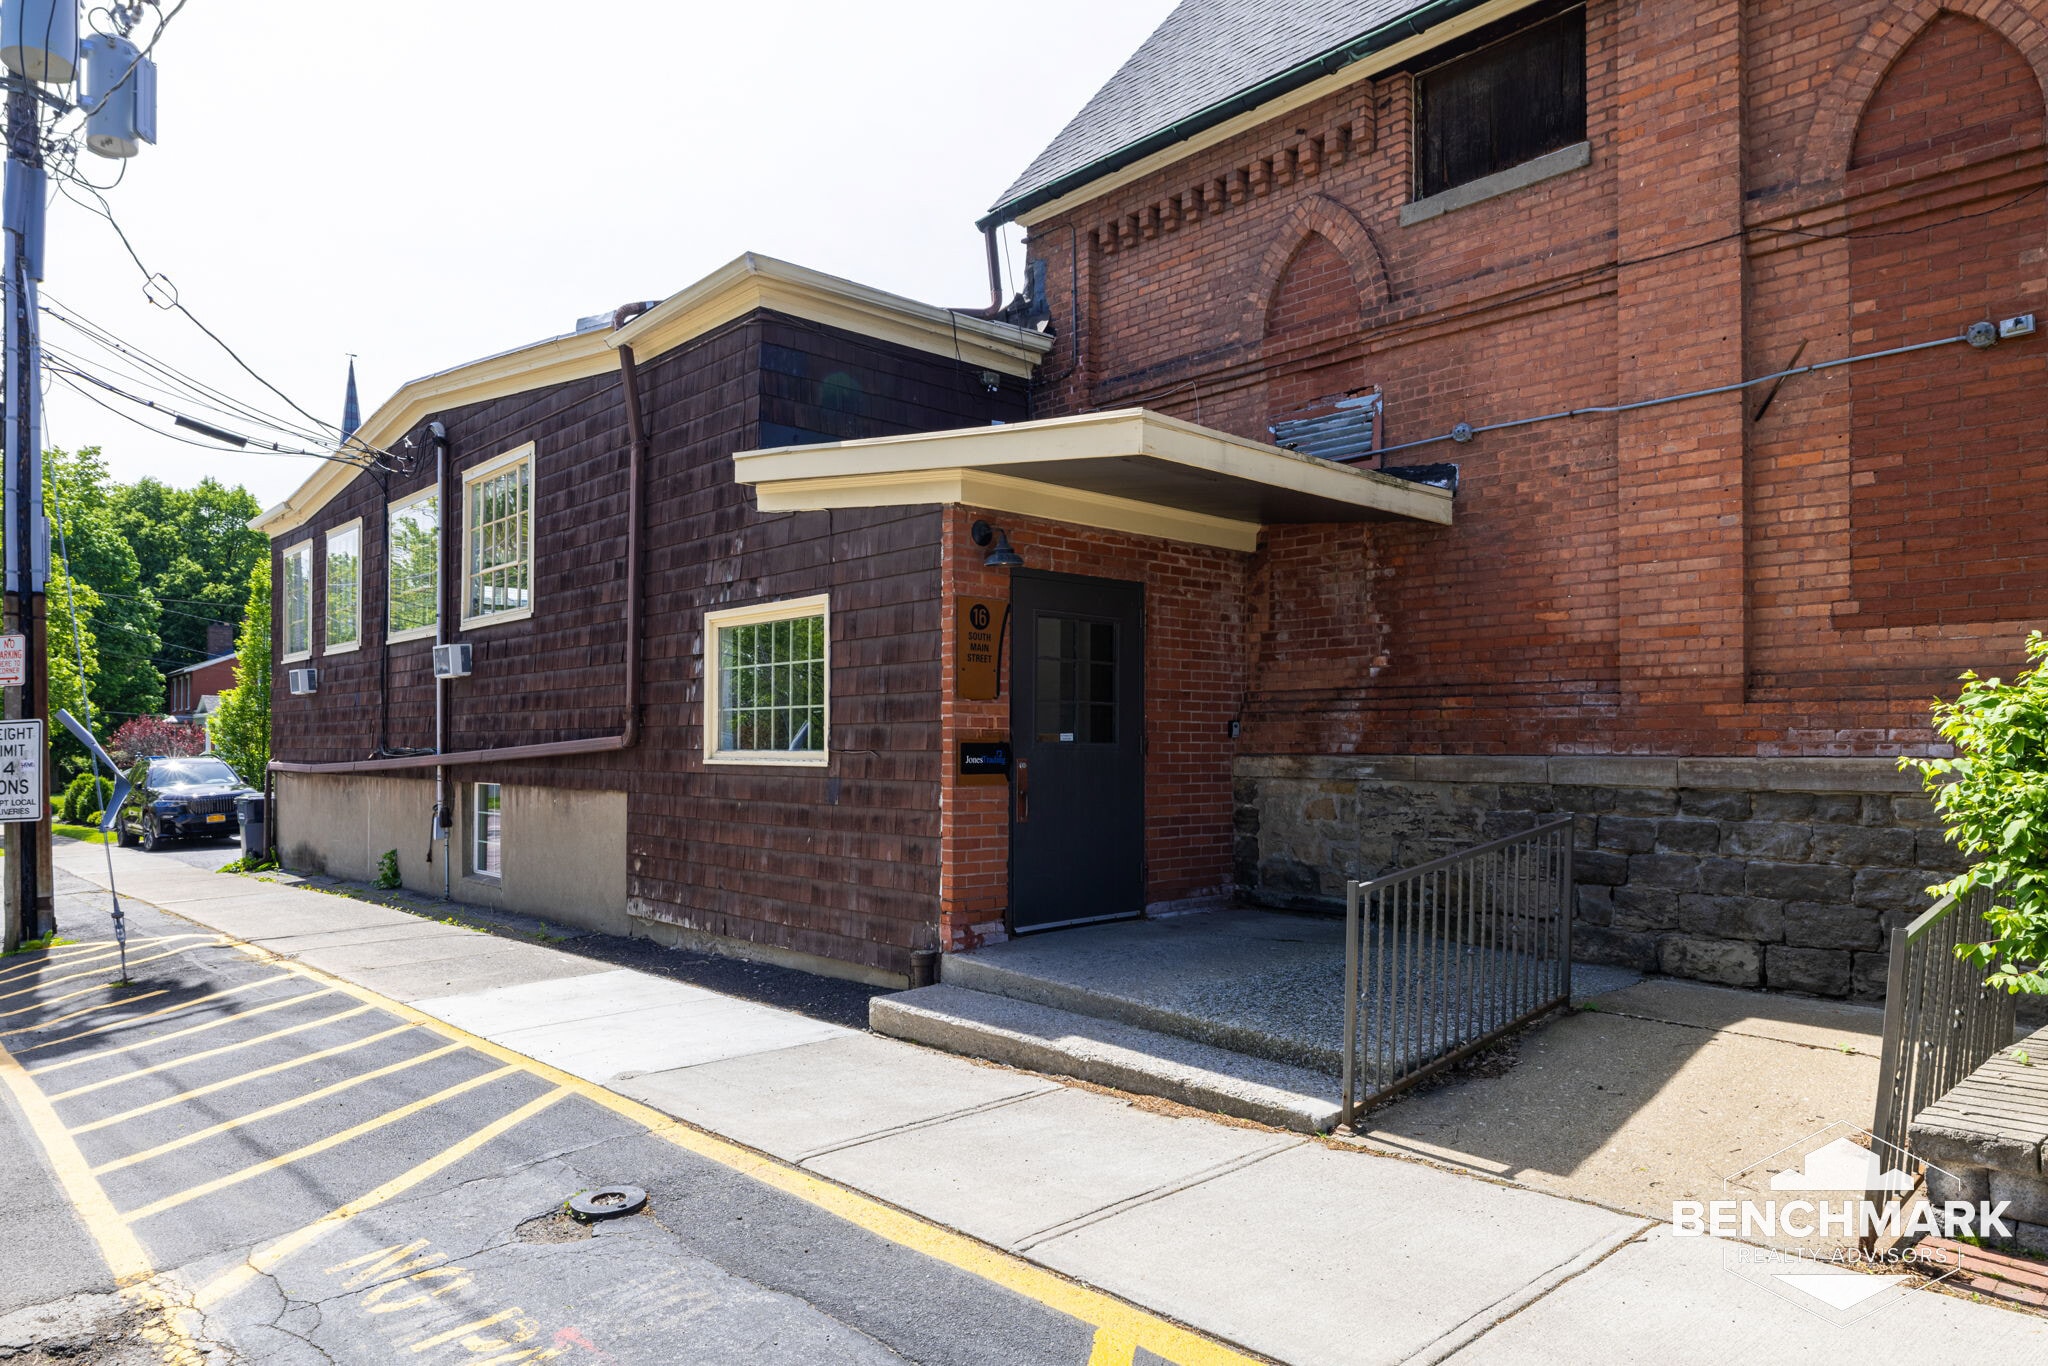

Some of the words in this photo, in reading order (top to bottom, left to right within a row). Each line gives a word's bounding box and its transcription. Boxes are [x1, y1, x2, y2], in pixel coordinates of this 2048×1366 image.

[973, 608, 988, 627] 16
[968, 631, 992, 642] SOUTH
[4, 639, 15, 649] NO
[969, 643, 990, 653] MAIN
[0, 650, 22, 660] ARKING
[967, 653, 993, 664] STREET
[0, 744, 26, 757] IMIT
[3, 761, 15, 775] 4
[0, 779, 29, 795] ONS
[11, 799, 37, 807] LOCAL
